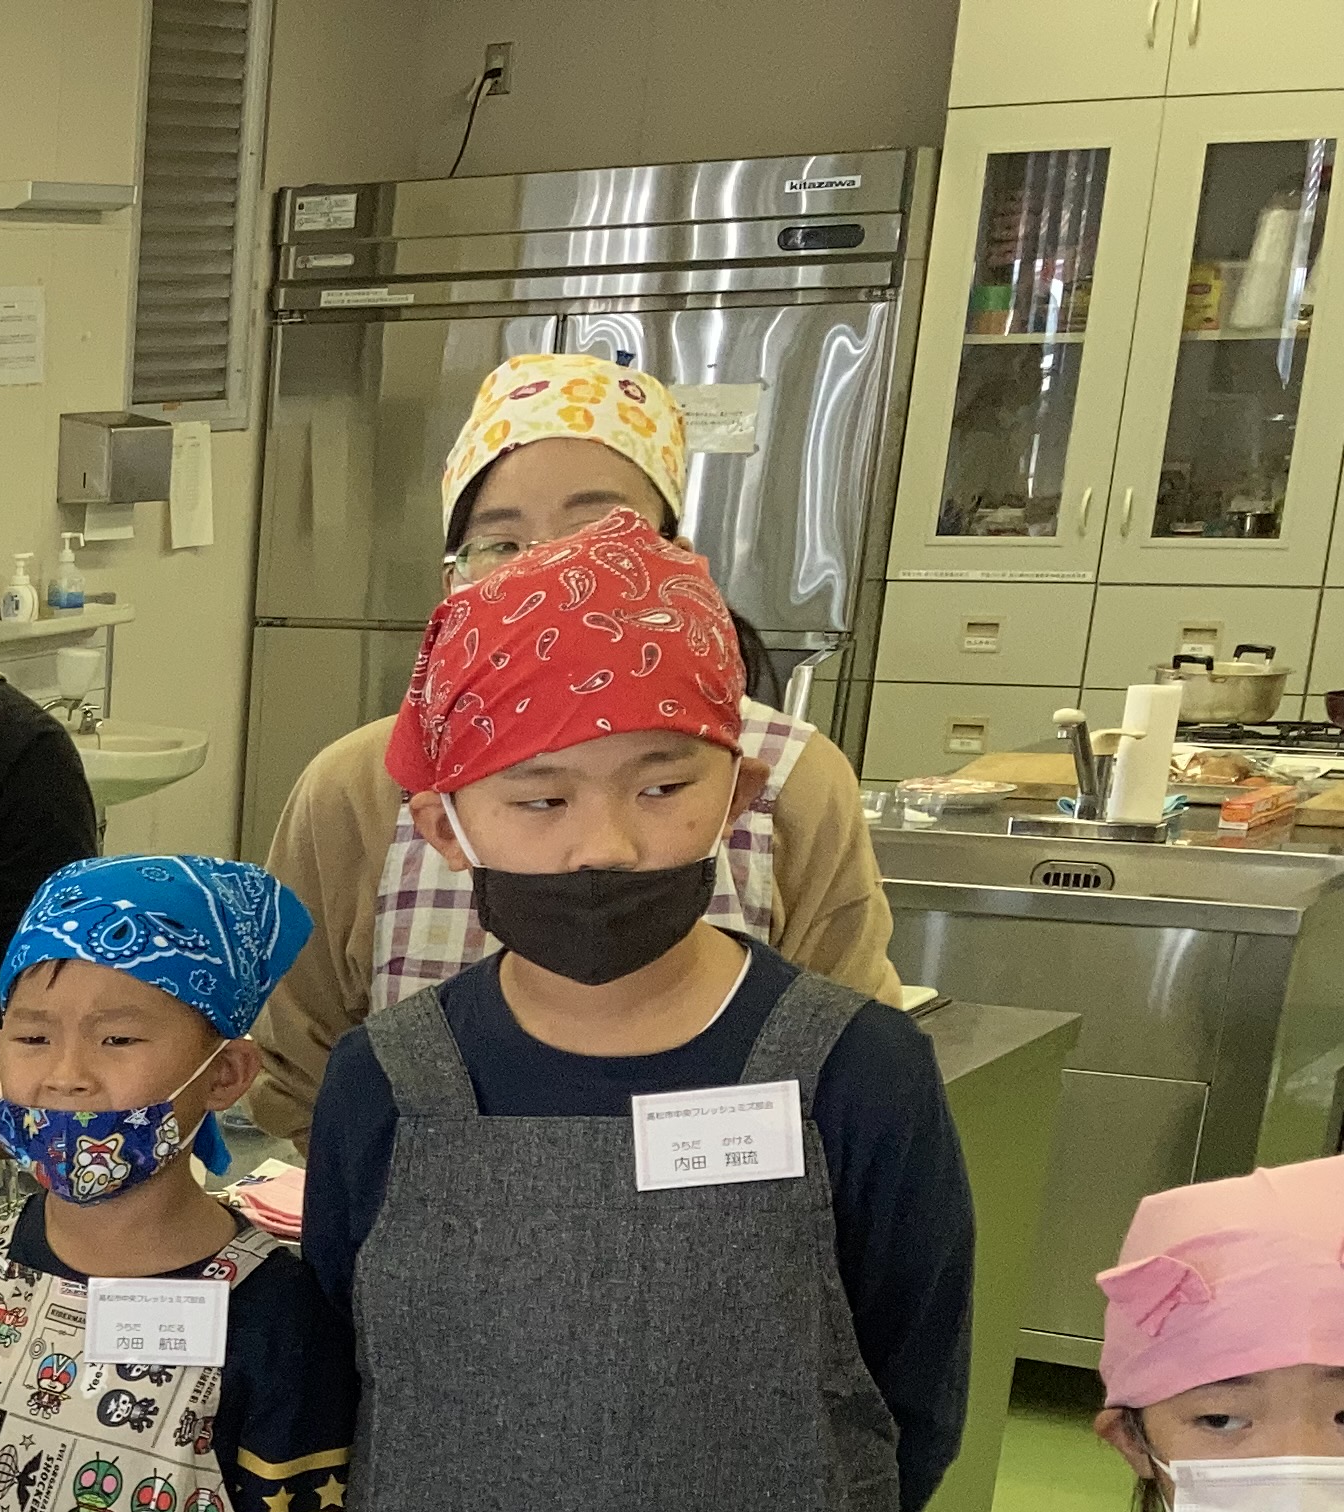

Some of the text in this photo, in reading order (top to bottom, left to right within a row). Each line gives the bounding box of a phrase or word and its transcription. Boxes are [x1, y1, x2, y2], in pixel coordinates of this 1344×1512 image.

[790, 179, 856, 191] kitazawa
[672, 1134, 754, 1152] うちだ かける
[674, 1154, 707, 1173] 内田
[116, 1336, 144, 1350] 内田
